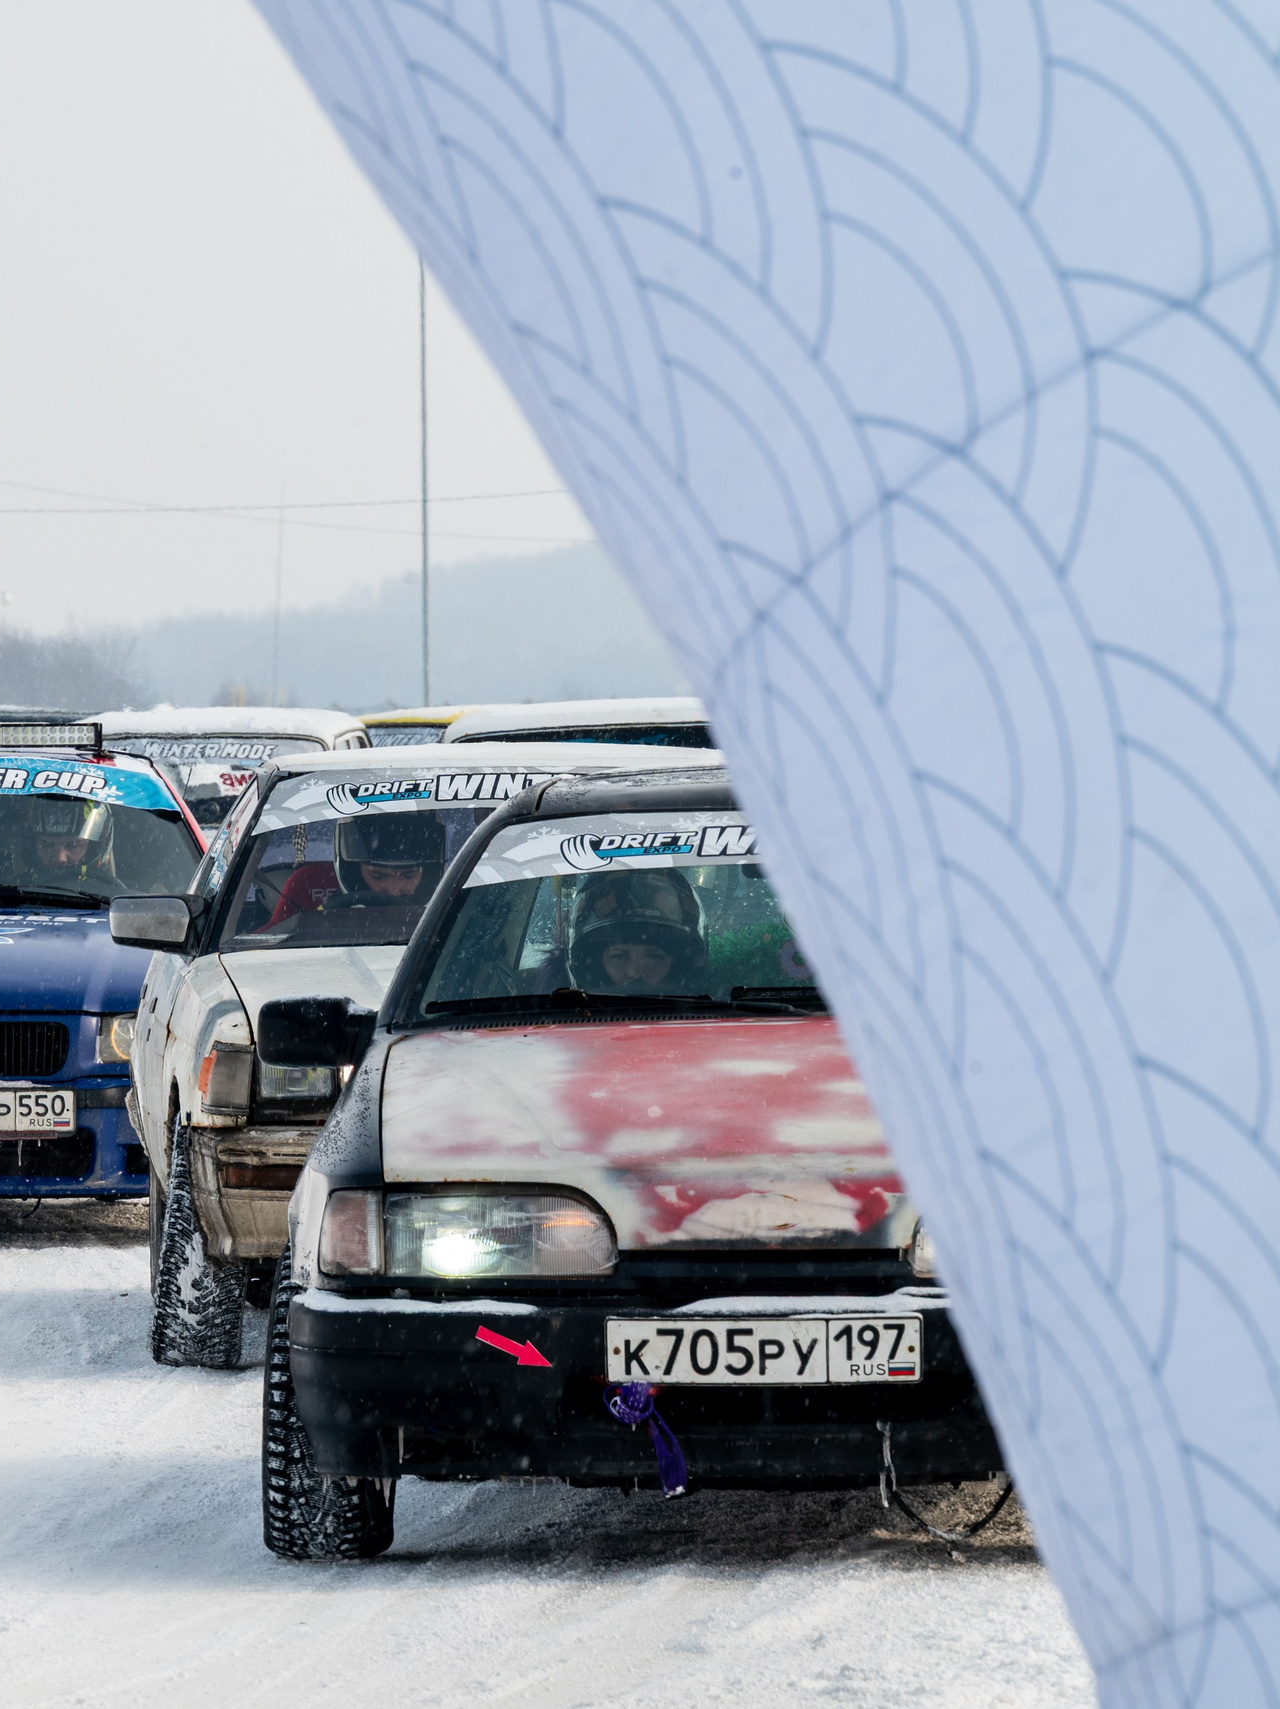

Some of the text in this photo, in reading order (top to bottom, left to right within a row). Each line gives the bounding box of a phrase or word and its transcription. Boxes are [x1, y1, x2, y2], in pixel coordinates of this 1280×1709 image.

[143, 741, 220, 759] WINTER
[220, 742, 277, 760] MODE
[32, 770, 107, 794] CUP
[358, 778, 434, 796] DRIFT
[392, 791, 422, 800] EXPO
[599, 831, 698, 850] DRIFT
[643, 846, 681, 854] EXPO
[18, 1094, 66, 1117] 550
[29, 1118, 53, 1127] RUS
[832, 1323, 906, 1361] 197
[849, 1363, 887, 1377] RUS
